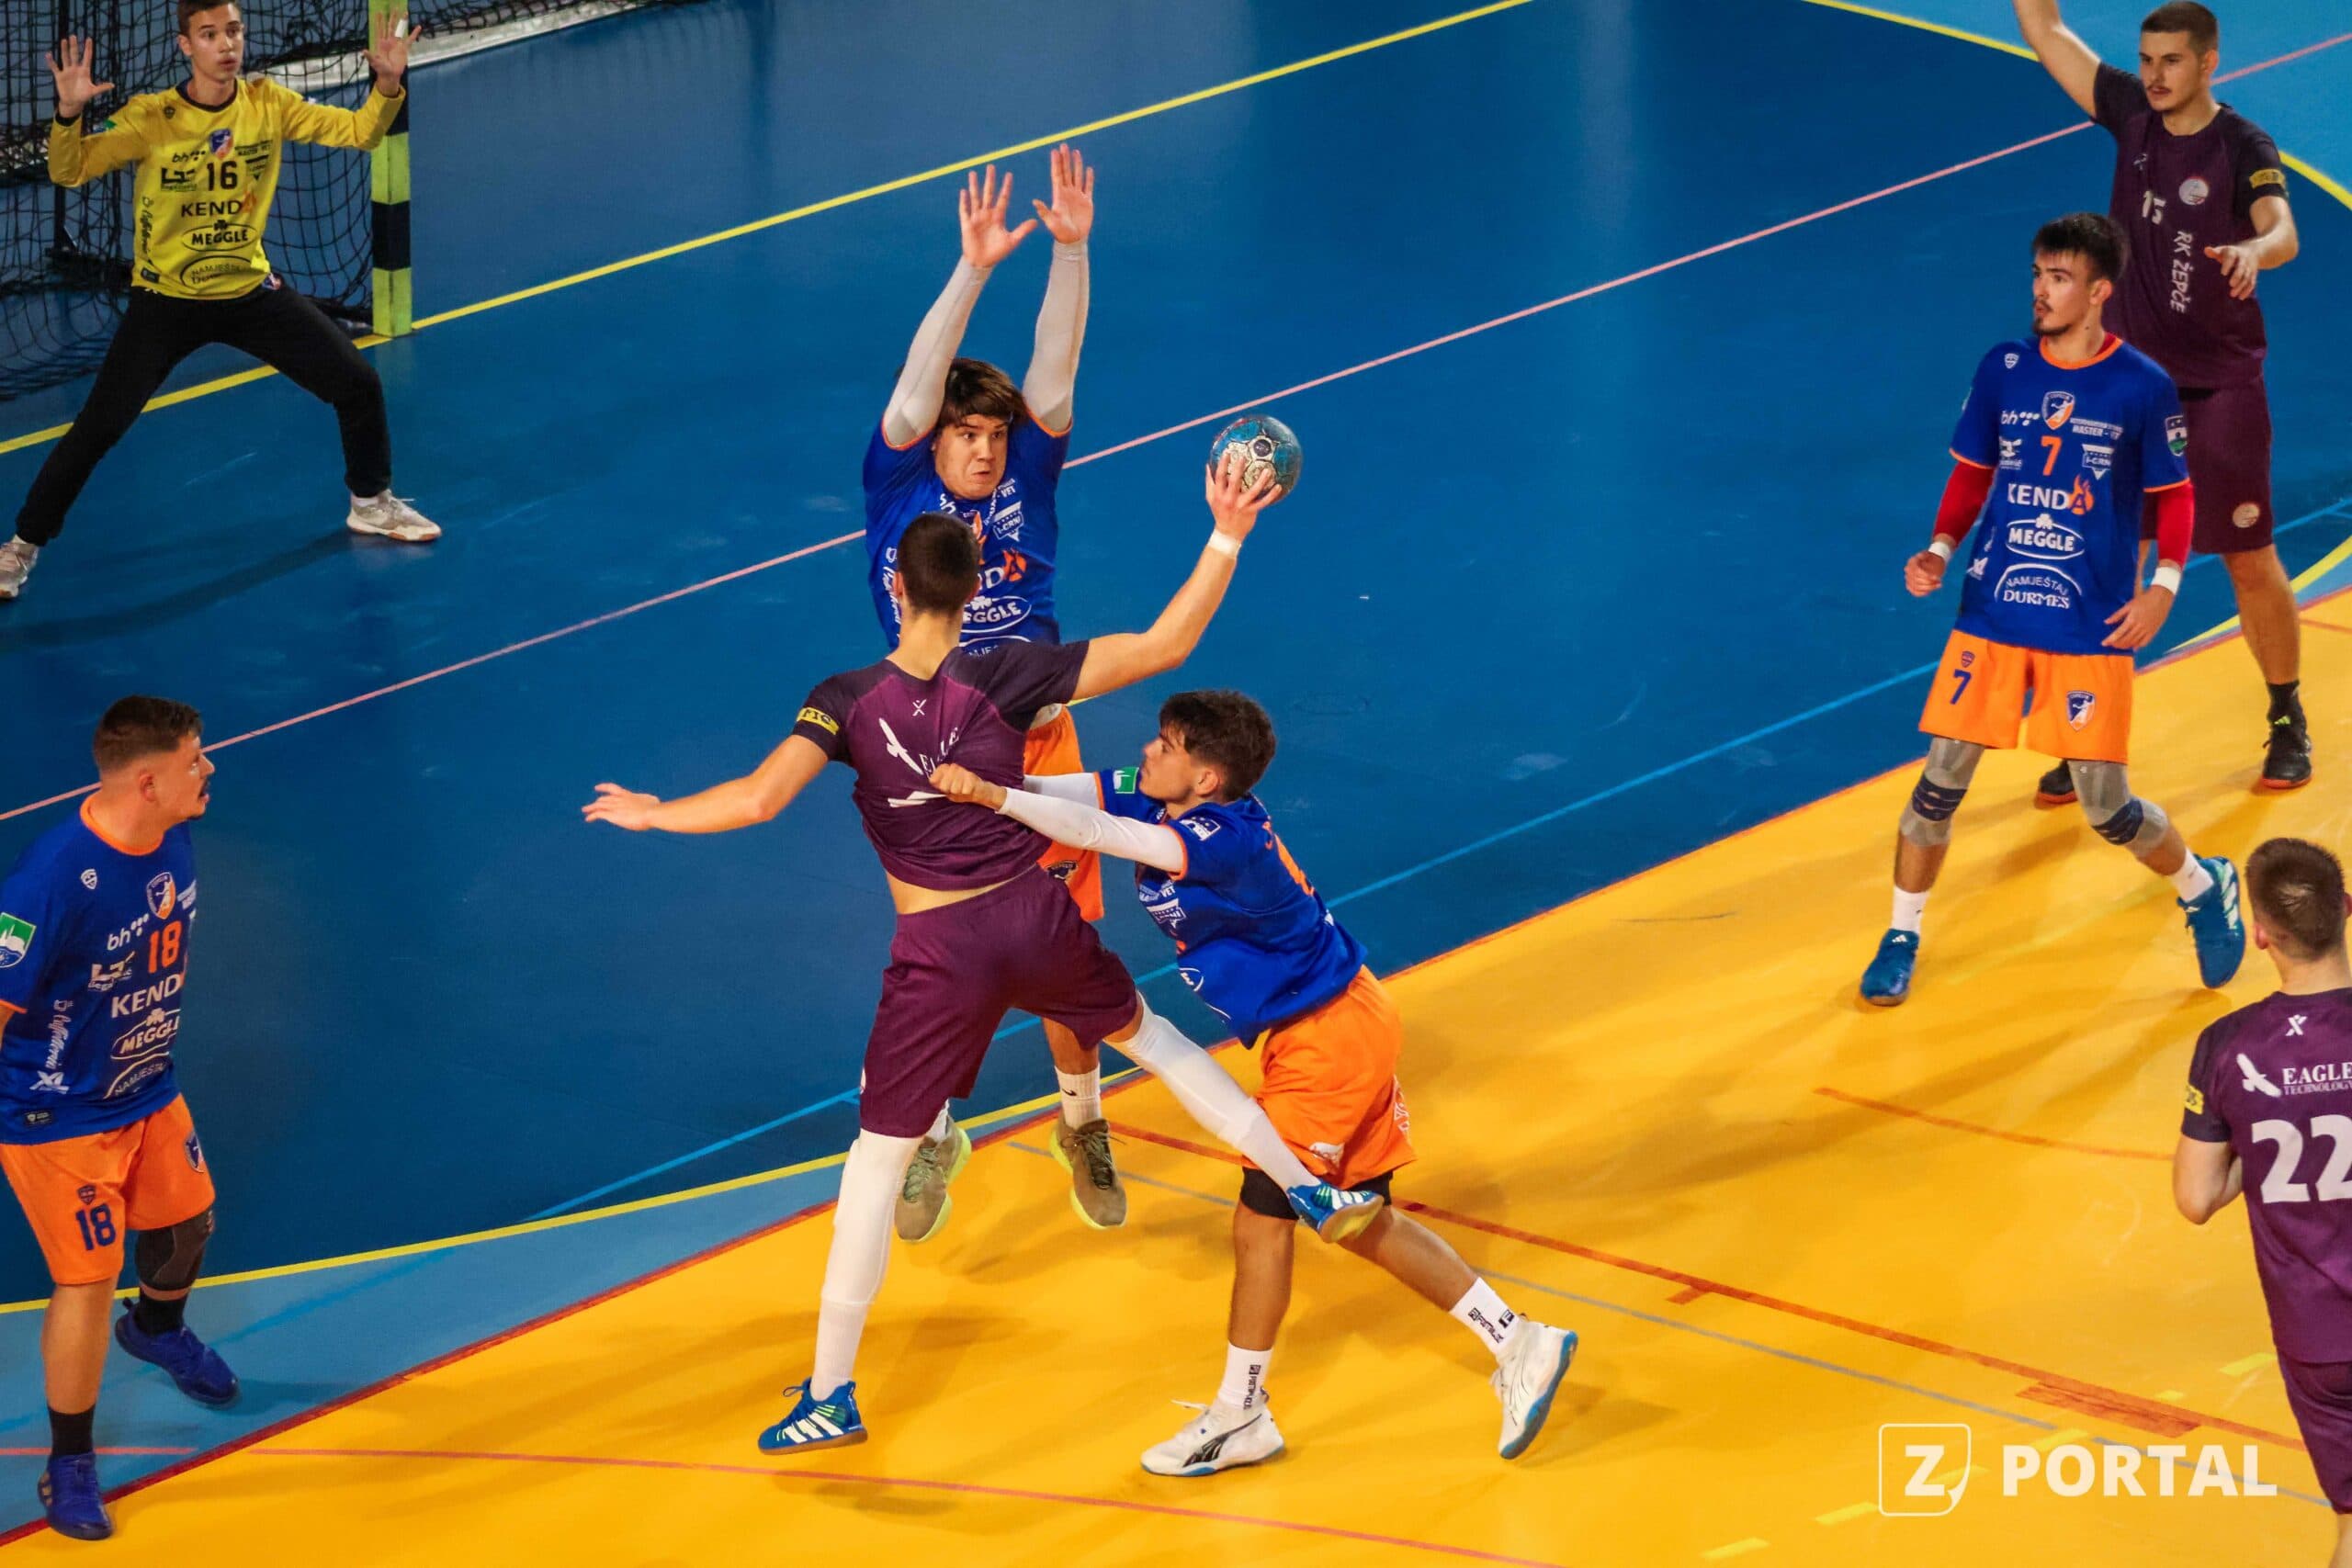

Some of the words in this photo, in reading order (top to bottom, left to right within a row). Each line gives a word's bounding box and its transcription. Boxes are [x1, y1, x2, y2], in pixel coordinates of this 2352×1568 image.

[207, 160, 238, 191] 16
[191, 229, 249, 245] MEGGLE
[2174, 231, 2193, 256] RK
[2169, 259, 2195, 313] ŽEPČE
[2041, 435, 2062, 476] 7
[1001, 486, 1016, 498] VET
[2008, 528, 2075, 552] MEGGLE
[962, 602, 1022, 624] EGGLE
[1949, 669, 1973, 705] 7
[148, 920, 183, 974] 18
[111, 971, 186, 1019] KEND
[119, 1015, 181, 1055] MEGGL
[2282, 1062, 2352, 1085] EAGLE
[2252, 1113, 2352, 1203] 22
[75, 1203, 117, 1251] 18
